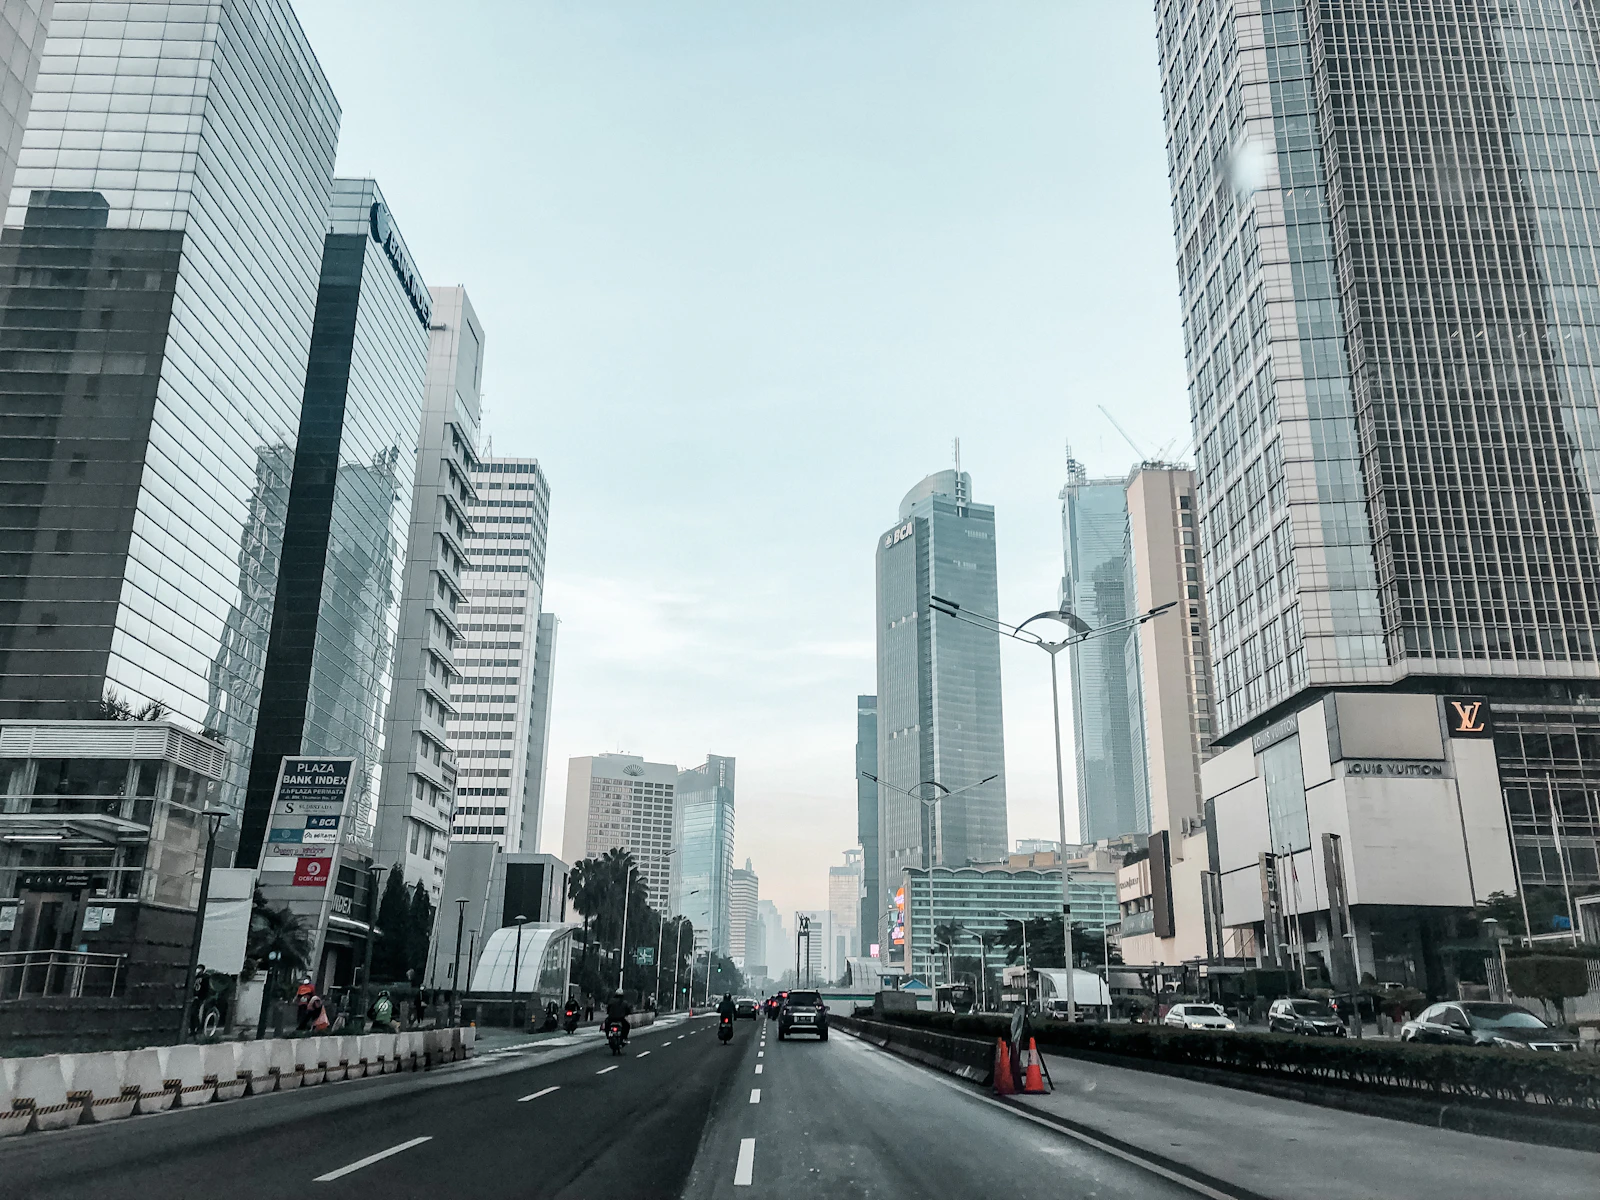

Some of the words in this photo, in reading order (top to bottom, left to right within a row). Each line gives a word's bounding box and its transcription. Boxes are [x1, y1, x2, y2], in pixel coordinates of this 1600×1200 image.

[893, 521, 913, 544] BCA
[1253, 731, 1271, 749] LOUIS
[1271, 717, 1297, 740] VUITTON
[297, 763, 335, 773] PLAZA
[1346, 763, 1384, 775] LOUIS
[1386, 764, 1443, 776] VUITTON
[282, 775, 312, 785] BANK
[314, 775, 348, 786] INDEX
[318, 818, 336, 827] BCA
